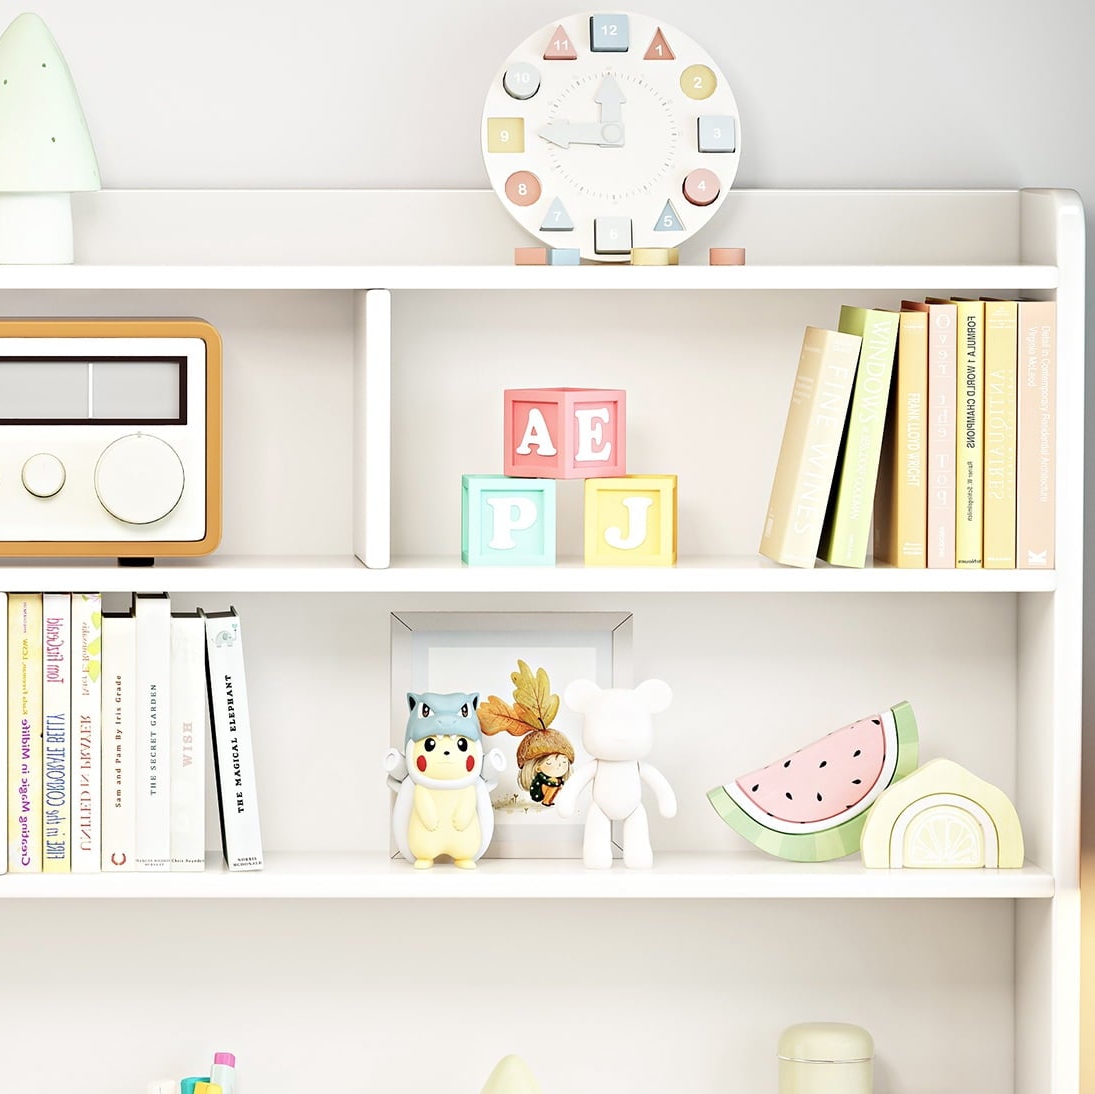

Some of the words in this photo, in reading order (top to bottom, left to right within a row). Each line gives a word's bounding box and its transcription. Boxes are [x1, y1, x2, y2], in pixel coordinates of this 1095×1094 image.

[602, 25, 617, 35] 12
[554, 40, 568, 50] 11
[656, 45, 663, 55] 1
[516, 72, 530, 83] 10
[693, 77, 702, 88] 2
[500, 131, 509, 142] 9
[713, 127, 721, 139] 3
[518, 183, 527, 195] 8
[697, 180, 706, 191] 4
[553, 211, 562, 222] 7
[664, 215, 673, 227] 5
[609, 229, 618, 240] 6
[858, 320, 891, 424] WINDOWS
[815, 365, 847, 427] FINE
[907, 393, 920, 421] FRANK
[516, 407, 558, 457] A
[575, 407, 611, 461] E
[907, 423, 920, 451] LLOYD
[907, 453, 920, 487] WRIGHT
[794, 442, 832, 534] WINES
[486, 496, 537, 550] P
[604, 496, 653, 549] J
[225, 674, 238, 732] ELEPHANT
[115, 730, 124, 740] By
[182, 722, 193, 767] WISH
[231, 737, 243, 786] MAGICAL
[235, 792, 244, 813] THE
